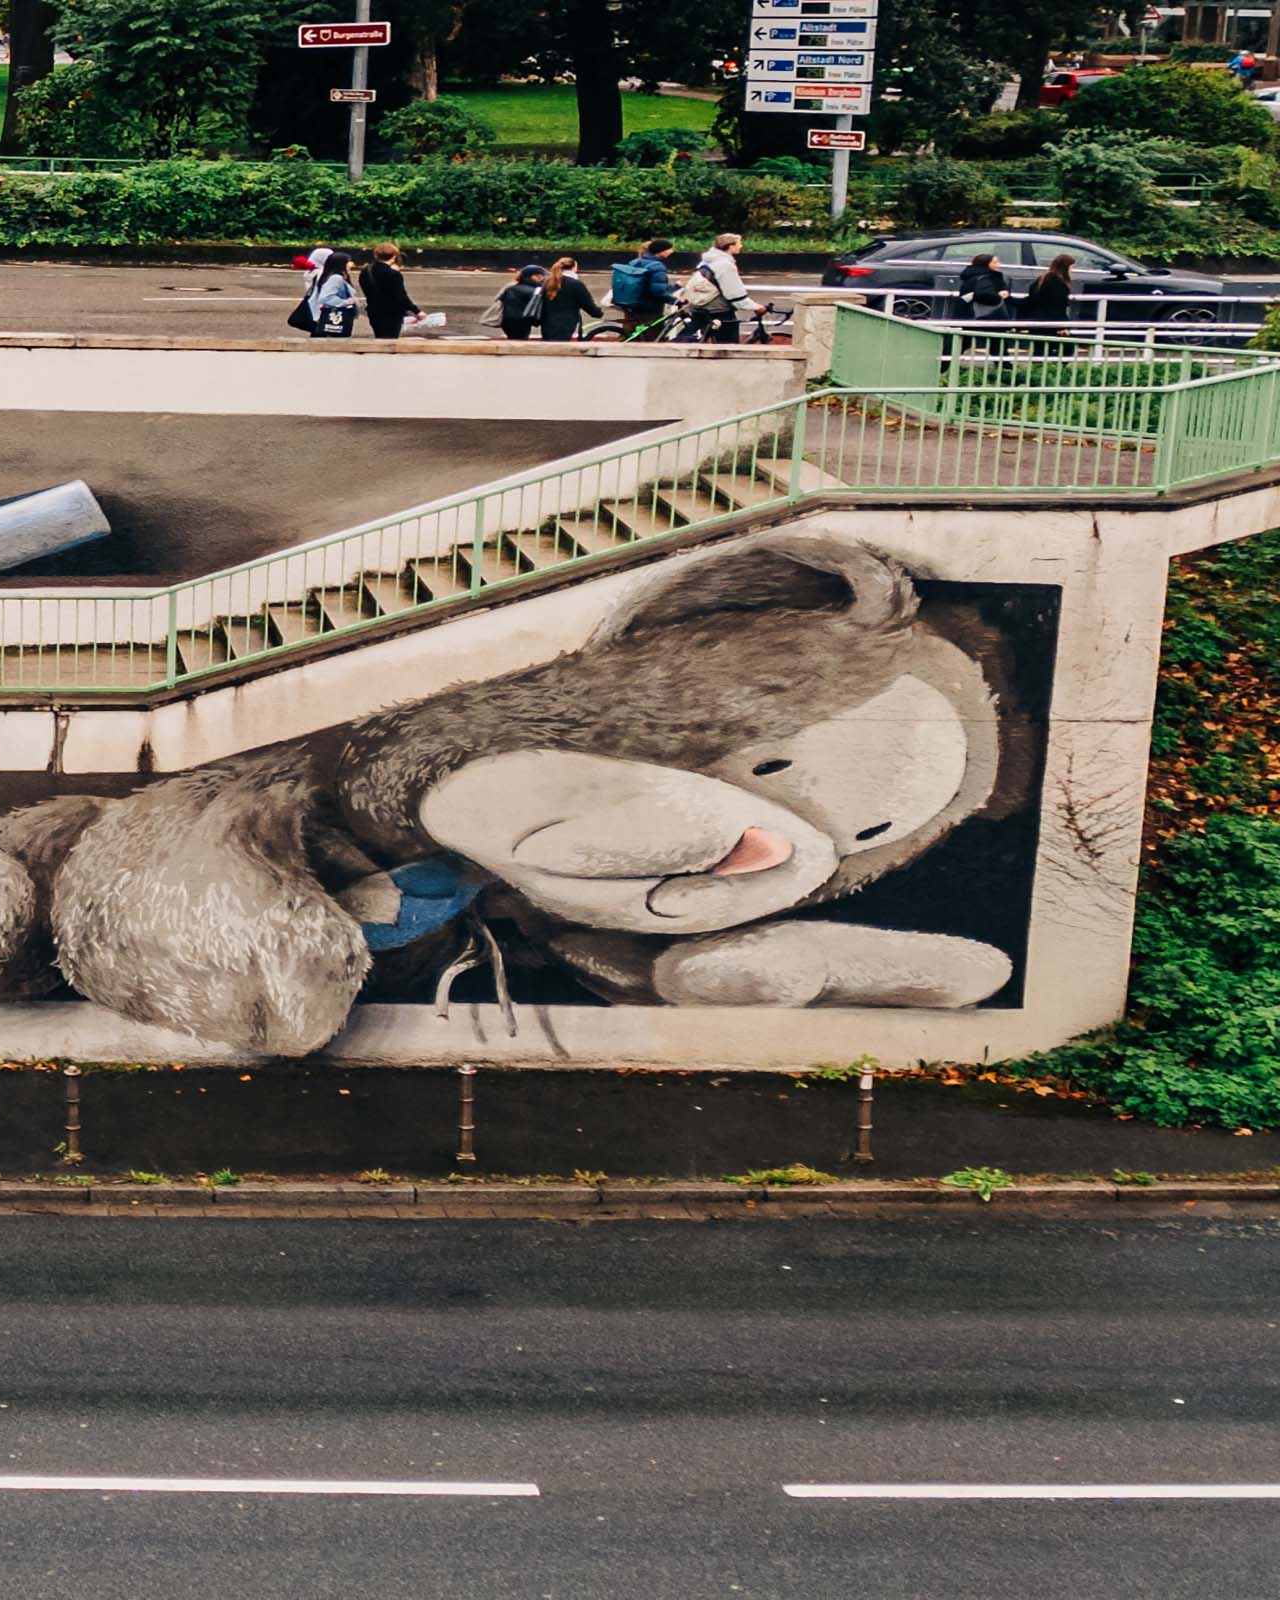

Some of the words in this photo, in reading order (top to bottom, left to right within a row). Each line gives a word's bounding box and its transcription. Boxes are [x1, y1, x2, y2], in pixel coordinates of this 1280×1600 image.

[801, 23, 838, 32] Altstadt
[799, 55, 835, 65] Altstadt
[838, 56, 862, 66] Nord
